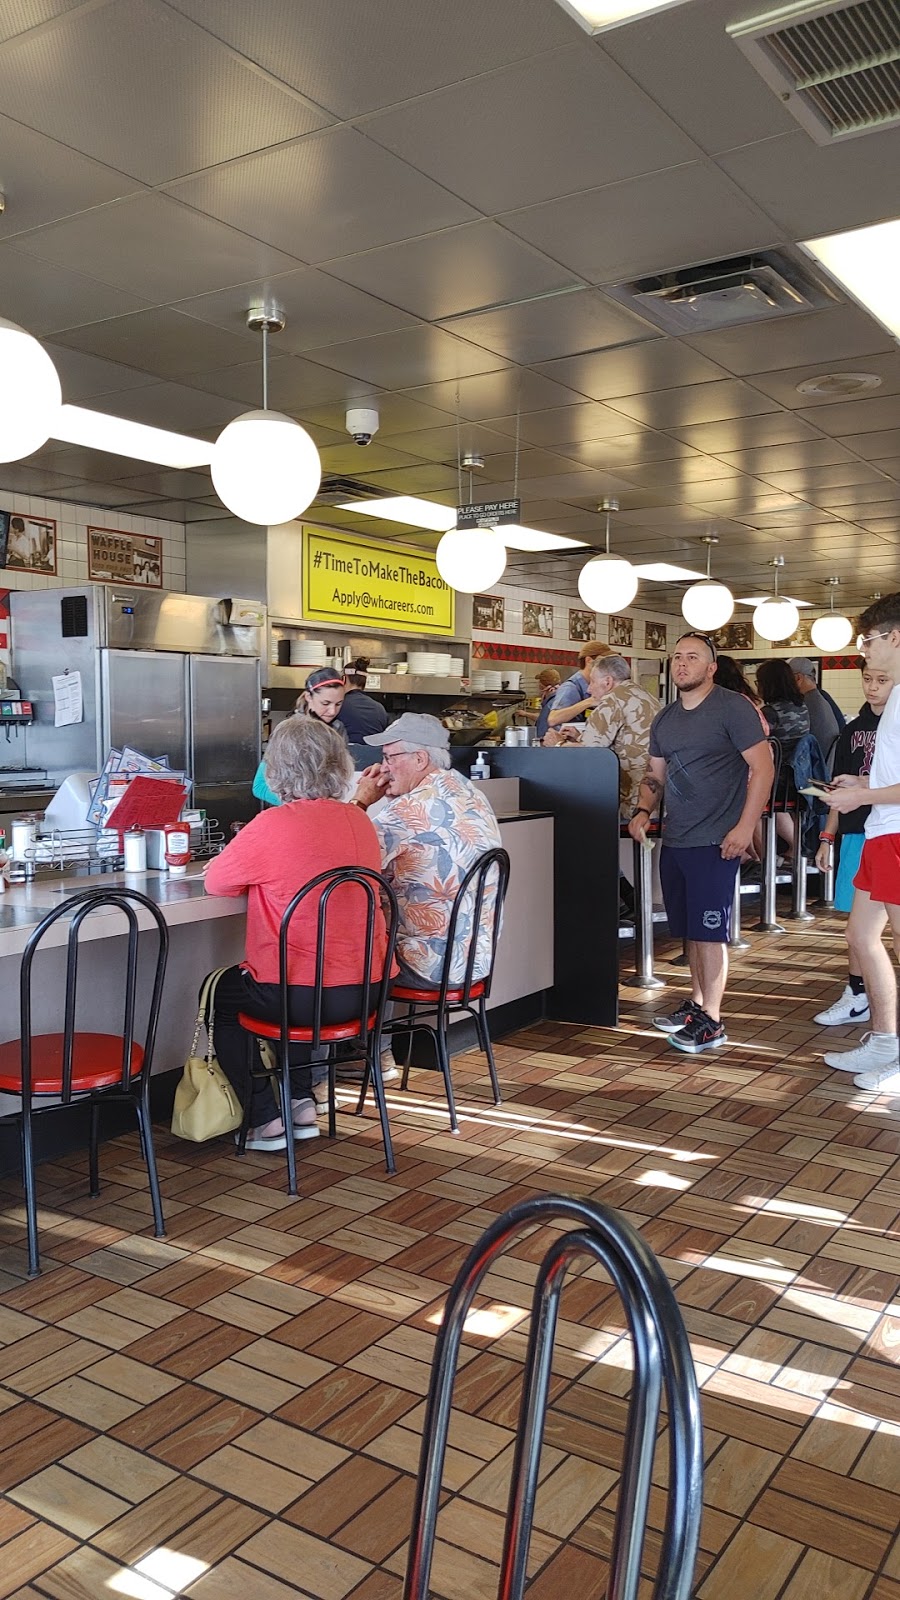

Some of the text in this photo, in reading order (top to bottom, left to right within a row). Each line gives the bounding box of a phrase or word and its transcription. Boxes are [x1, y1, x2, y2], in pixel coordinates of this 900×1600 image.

[457, 505, 484, 515] PLEASE
[499, 501, 519, 510] HERE
[91, 534, 132, 552] WAFFLE
[93, 548, 131, 565] HOUSE
[313, 550, 449, 591] #TimeToMakeTheBacon
[332, 587, 434, 616] Apply@whcareers.com
